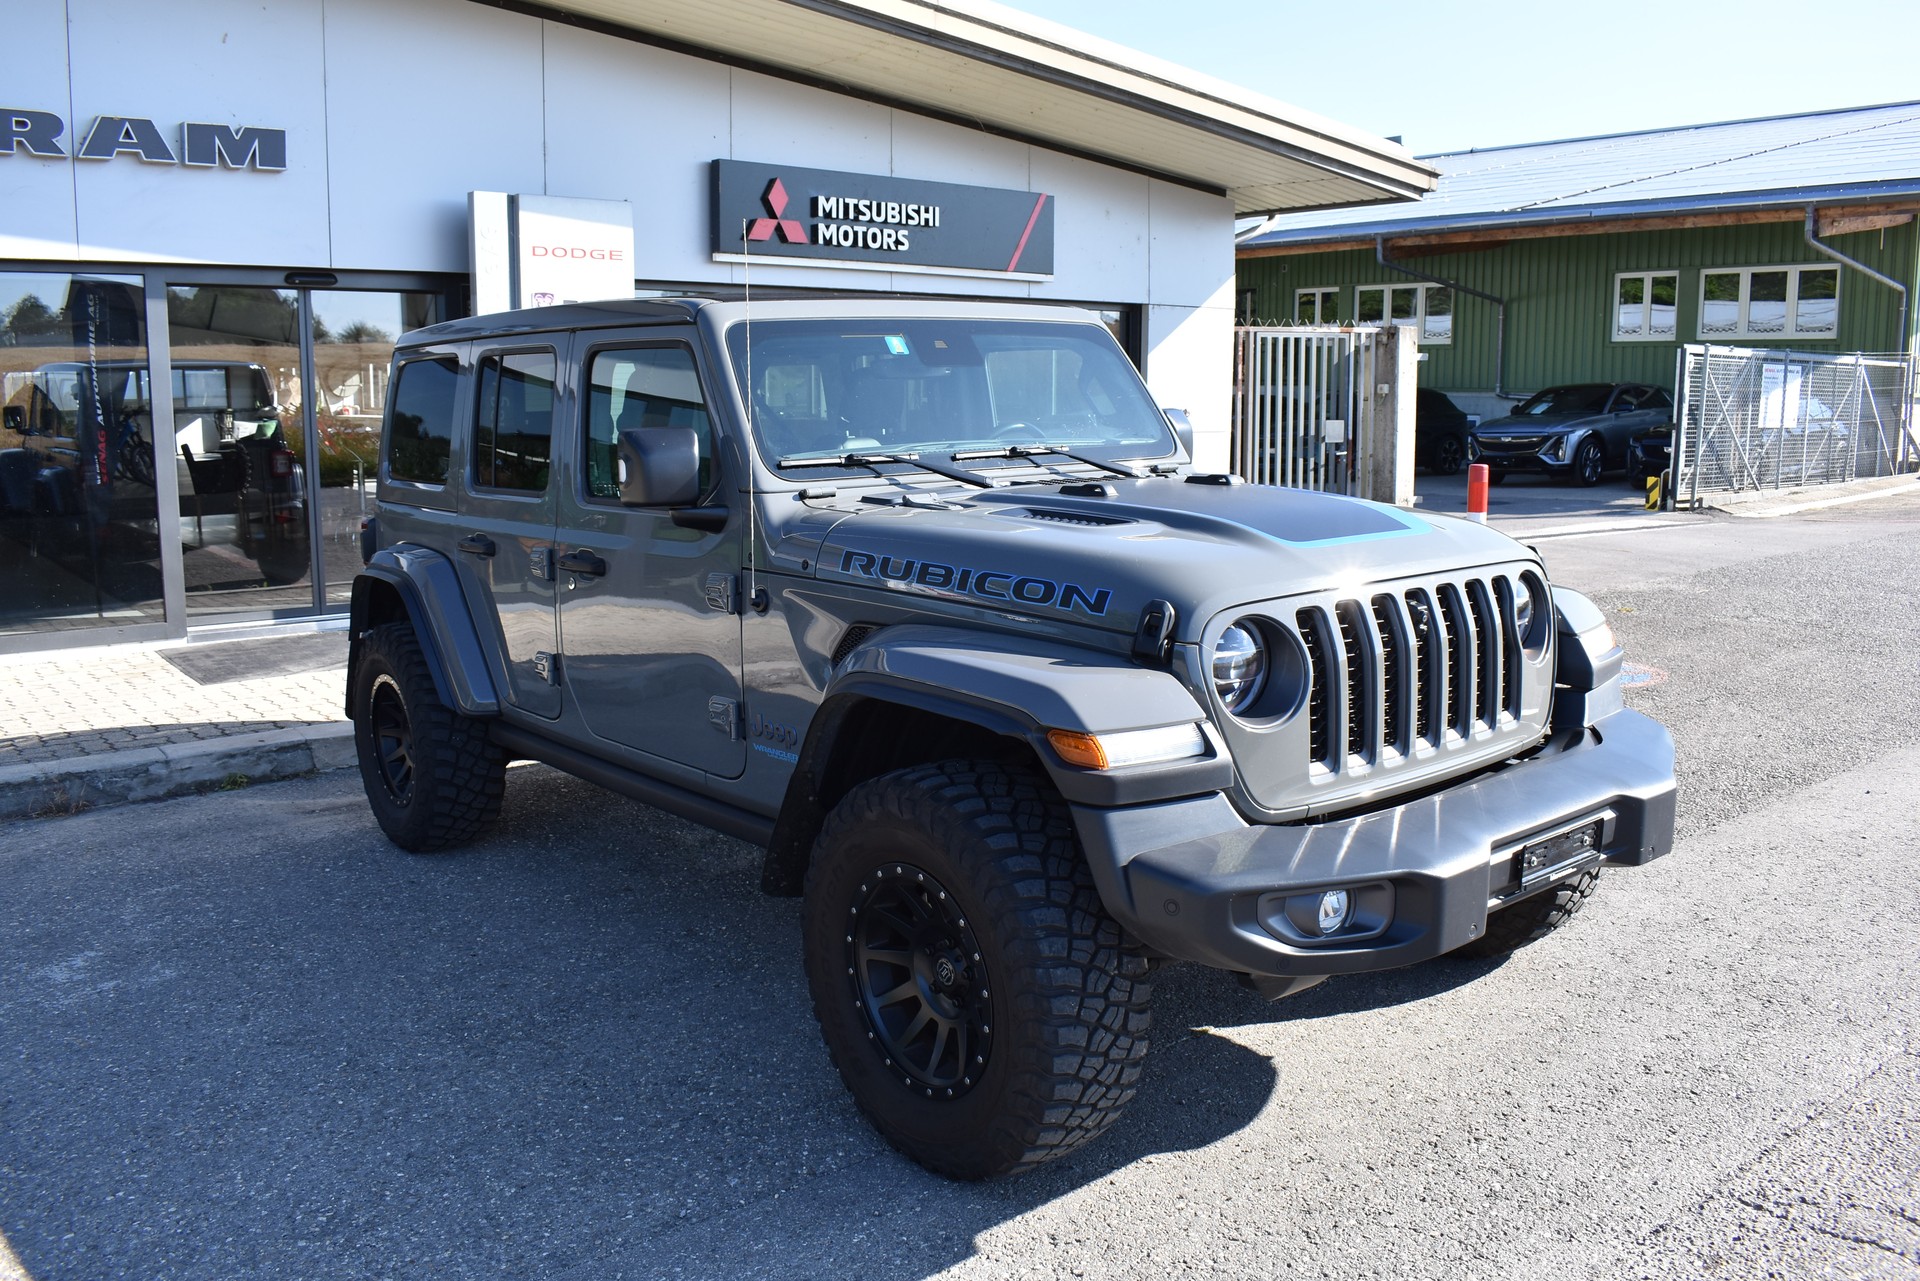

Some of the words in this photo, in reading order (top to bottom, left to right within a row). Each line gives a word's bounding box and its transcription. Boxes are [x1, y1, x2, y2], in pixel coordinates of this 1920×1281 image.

[0, 108, 287, 171] RAM
[817, 195, 940, 227] MITSUBISHI
[531, 245, 623, 261] DODGE
[817, 223, 910, 251] MOTORS
[87, 293, 96, 318] AG
[88, 320, 105, 426] AUTOMOBILE
[98, 430, 109, 485] SENAG
[839, 549, 1113, 616] RUBICON
[752, 713, 798, 750] Jeep
[752, 742, 798, 761] WRANGLER
